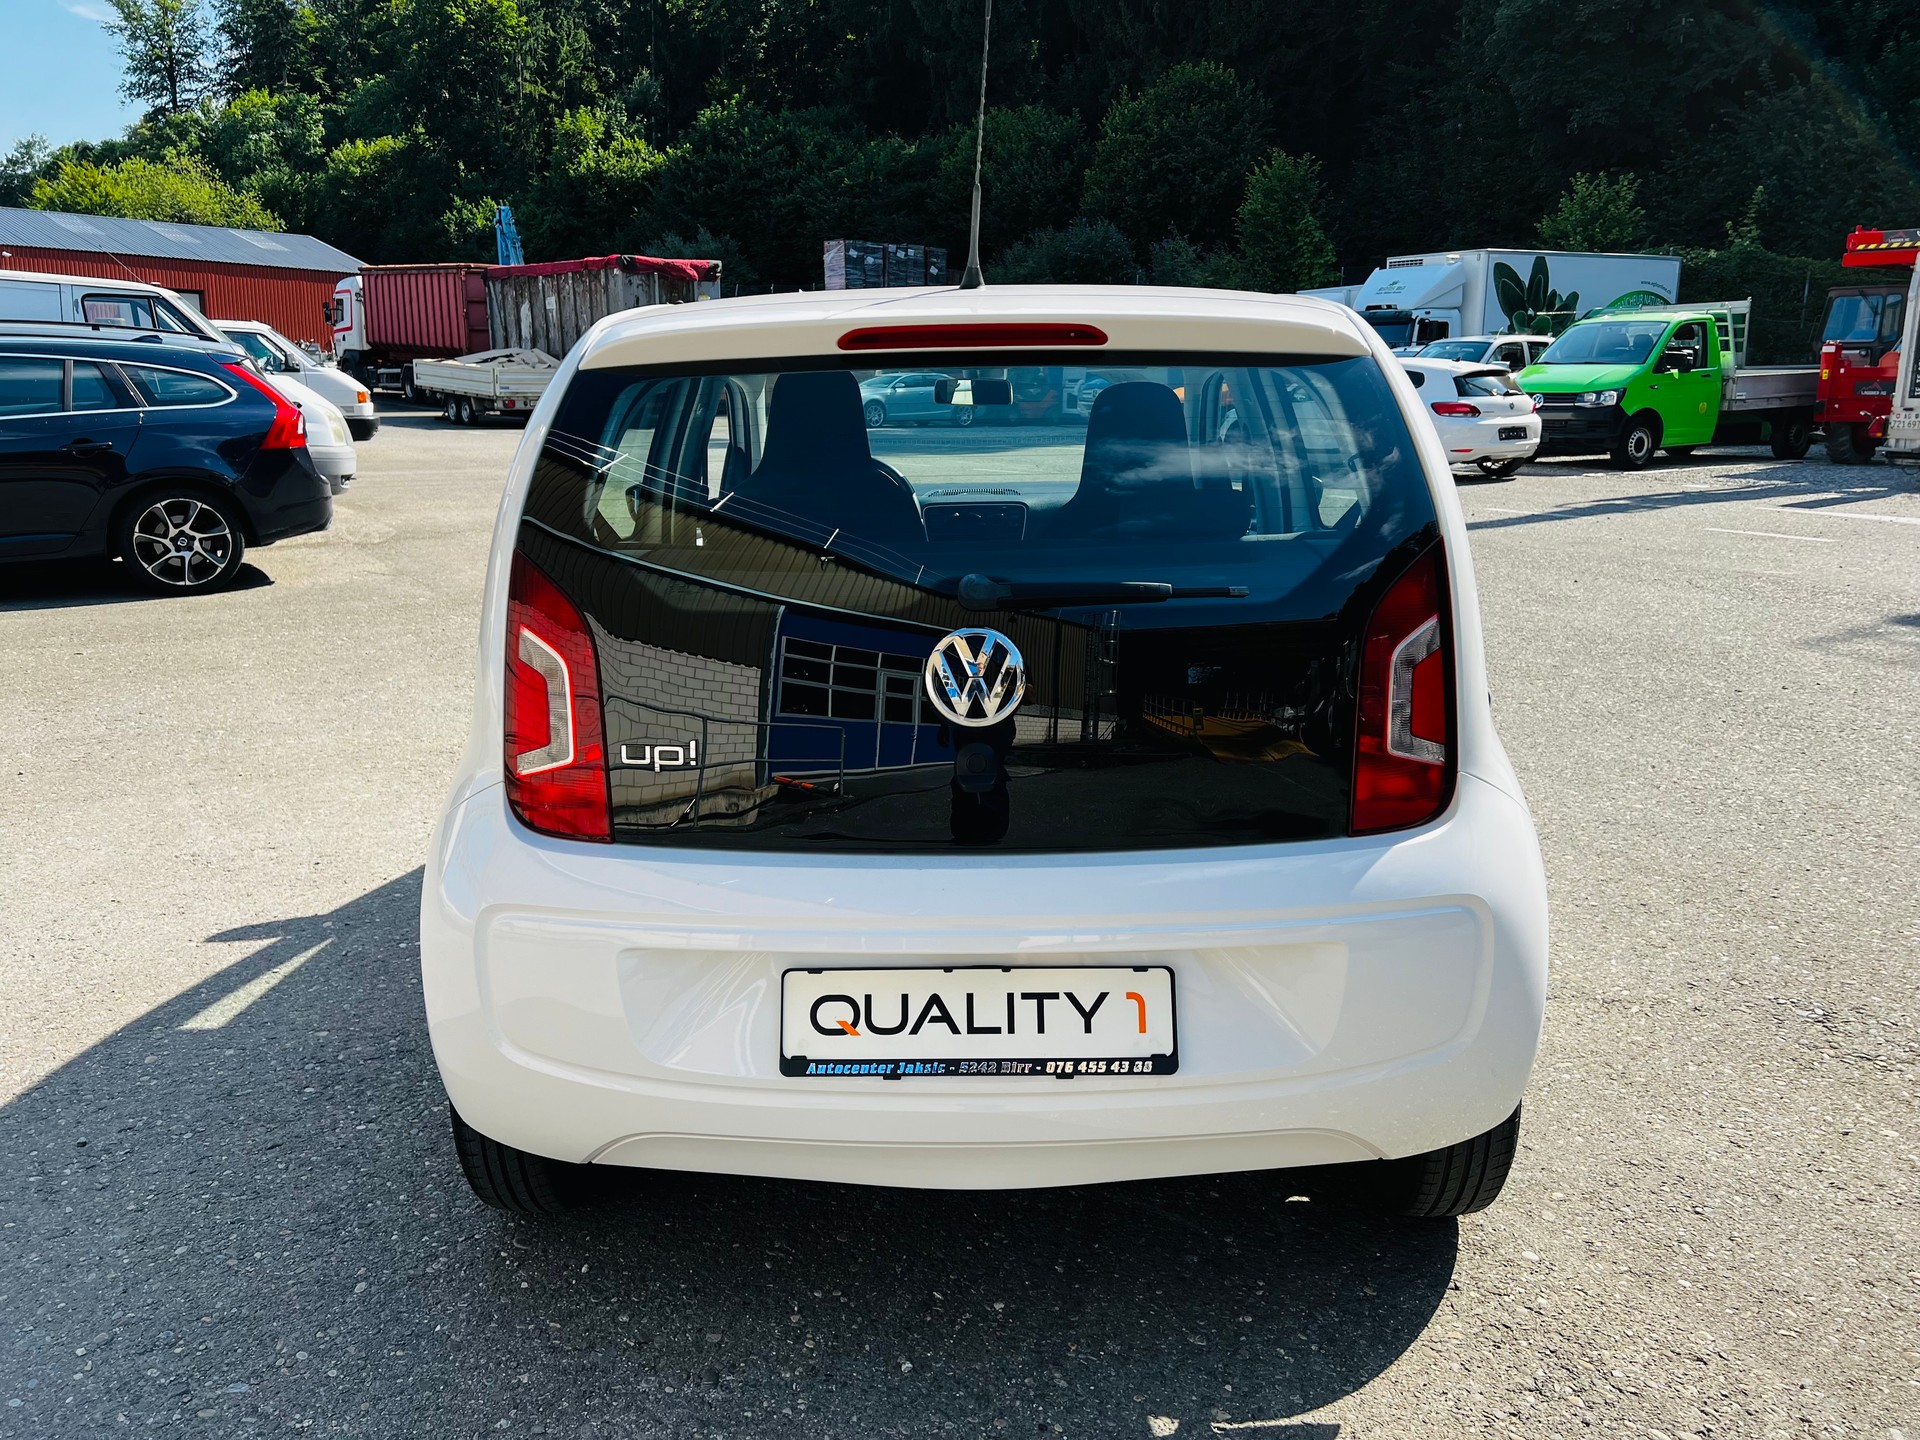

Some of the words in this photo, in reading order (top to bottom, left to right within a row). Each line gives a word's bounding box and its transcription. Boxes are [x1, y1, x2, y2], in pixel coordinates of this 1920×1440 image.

[621, 740, 697, 772] up!
[809, 991, 1110, 1036] QUALITY
[1125, 991, 1147, 1034] 1
[806, 1062, 894, 1075] Autocenter
[897, 1061, 946, 1074] Jaksic
[958, 1061, 997, 1074] 5242
[1001, 1061, 1032, 1073] Birr
[1045, 1061, 1074, 1073] 076
[1077, 1061, 1107, 1073] 455
[1110, 1061, 1130, 1073] 43
